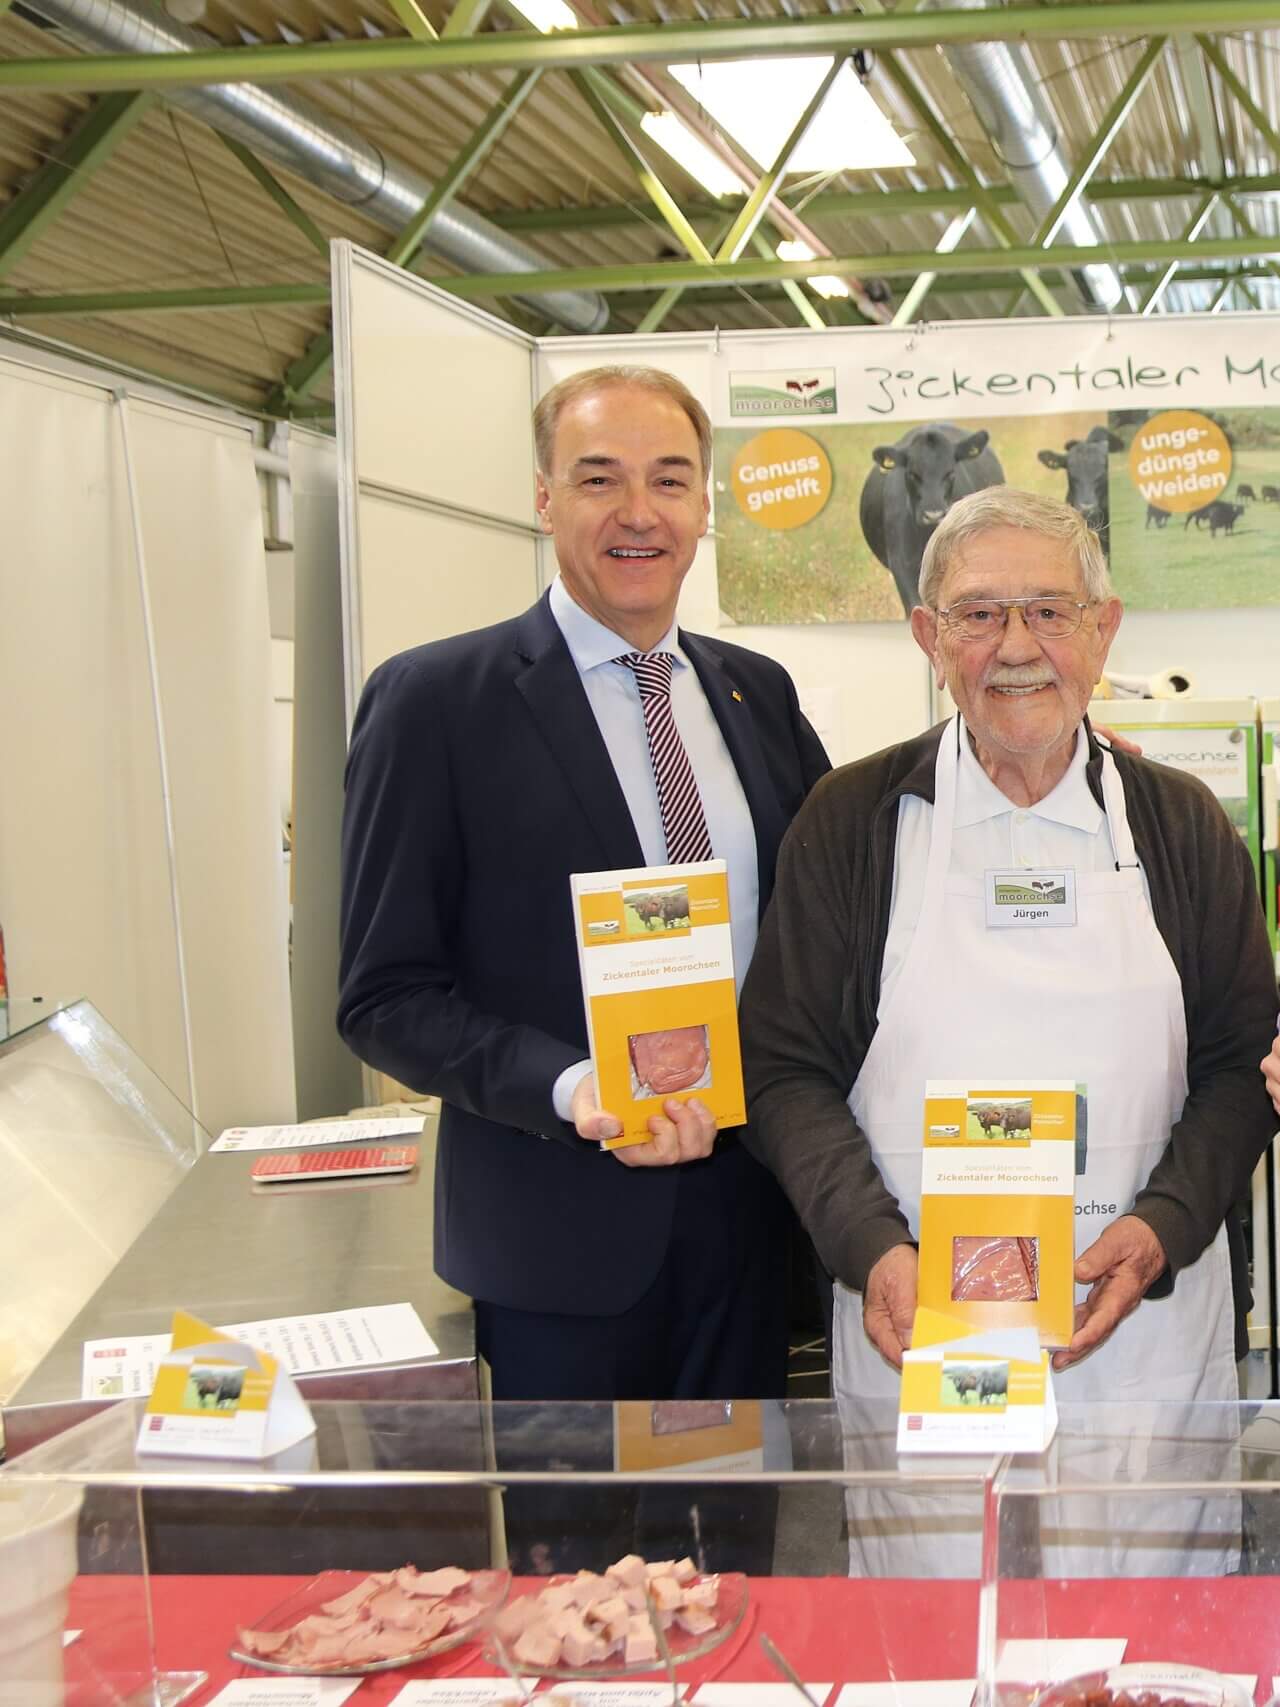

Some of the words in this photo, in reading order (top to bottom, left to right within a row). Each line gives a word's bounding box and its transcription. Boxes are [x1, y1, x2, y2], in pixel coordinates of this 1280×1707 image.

[864, 357, 1199, 413] Zickentaler
[735, 397, 833, 411] moorochse
[1141, 428, 1208, 451] unge-
[739, 455, 820, 485] Genuss
[1138, 448, 1220, 476] düngte
[747, 477, 820, 511] gereift
[1139, 472, 1226, 500] Weiden
[999, 892, 1064, 901] moorochse
[1013, 909, 1049, 919] Jürgen
[602, 967, 660, 982] Zickentaler
[663, 959, 720, 975] Moorochsen
[937, 1173, 993, 1183] Zickentaler
[998, 1173, 1058, 1183] Moorochsen
[1074, 1200, 1117, 1216] ochse
